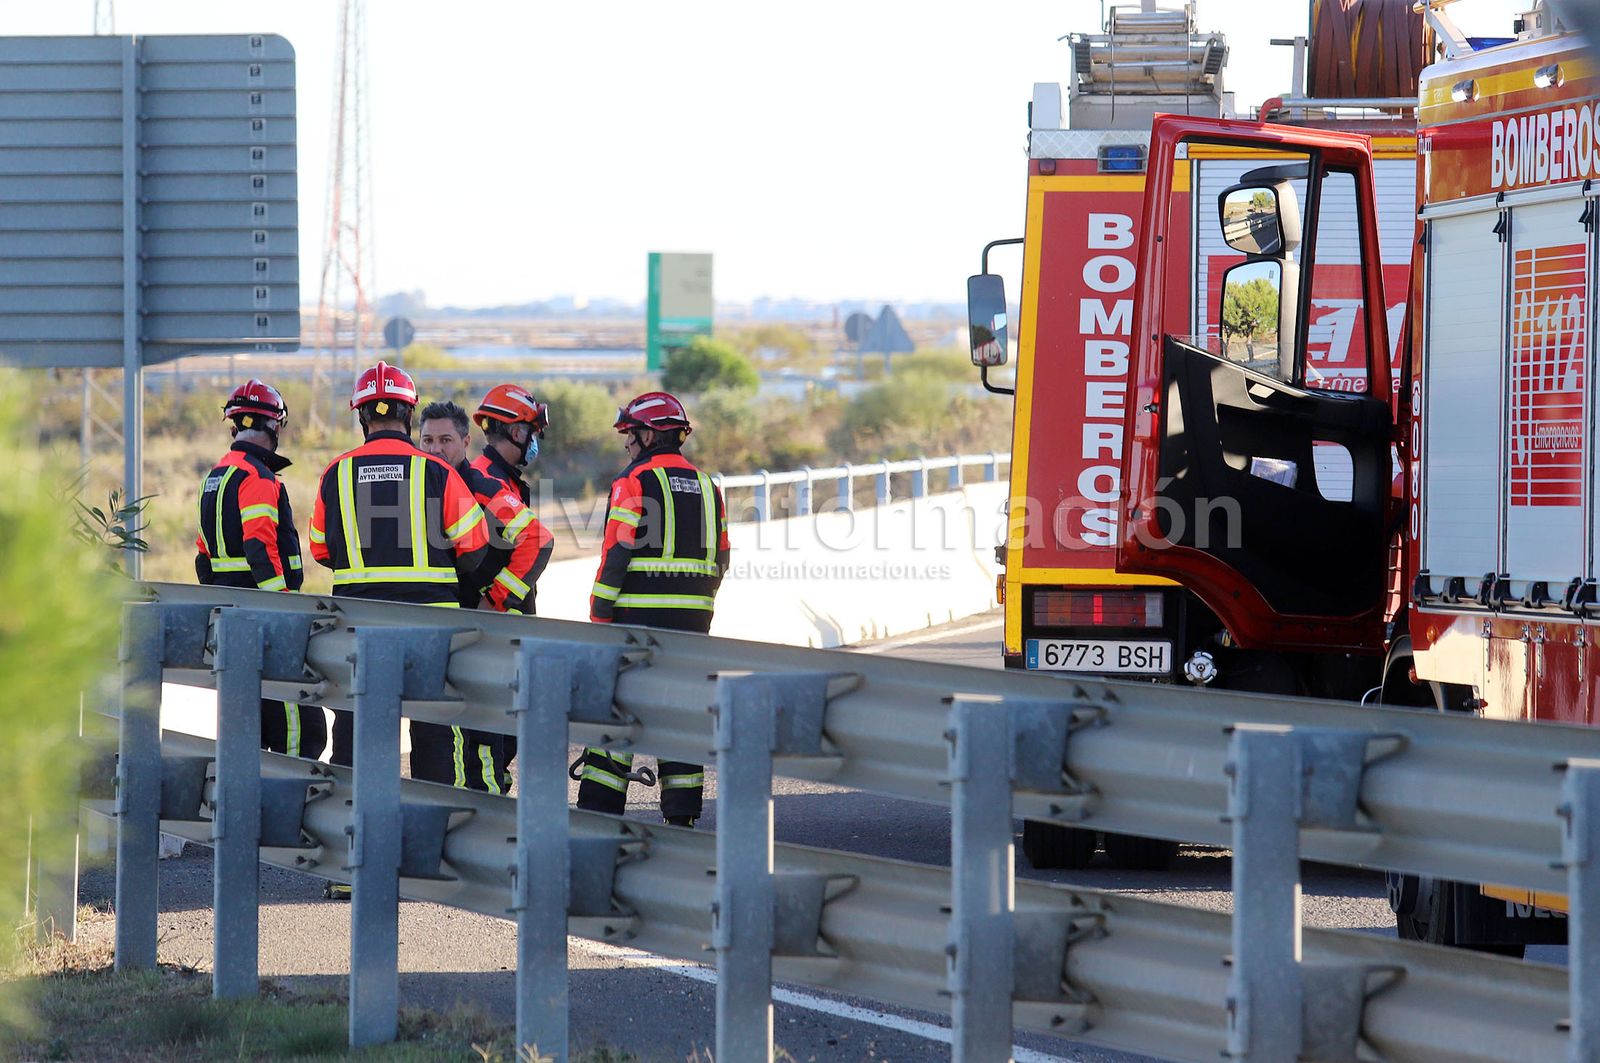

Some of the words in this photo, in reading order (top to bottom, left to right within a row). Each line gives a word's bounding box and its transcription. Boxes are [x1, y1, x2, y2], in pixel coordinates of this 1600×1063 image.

[1491, 101, 1600, 189] BOMBEROS
[1077, 212, 1137, 547] BOMBEROS
[363, 466, 399, 474] BOMBEROS
[1045, 643, 1105, 666] 6773
[1118, 645, 1164, 669] BSH
